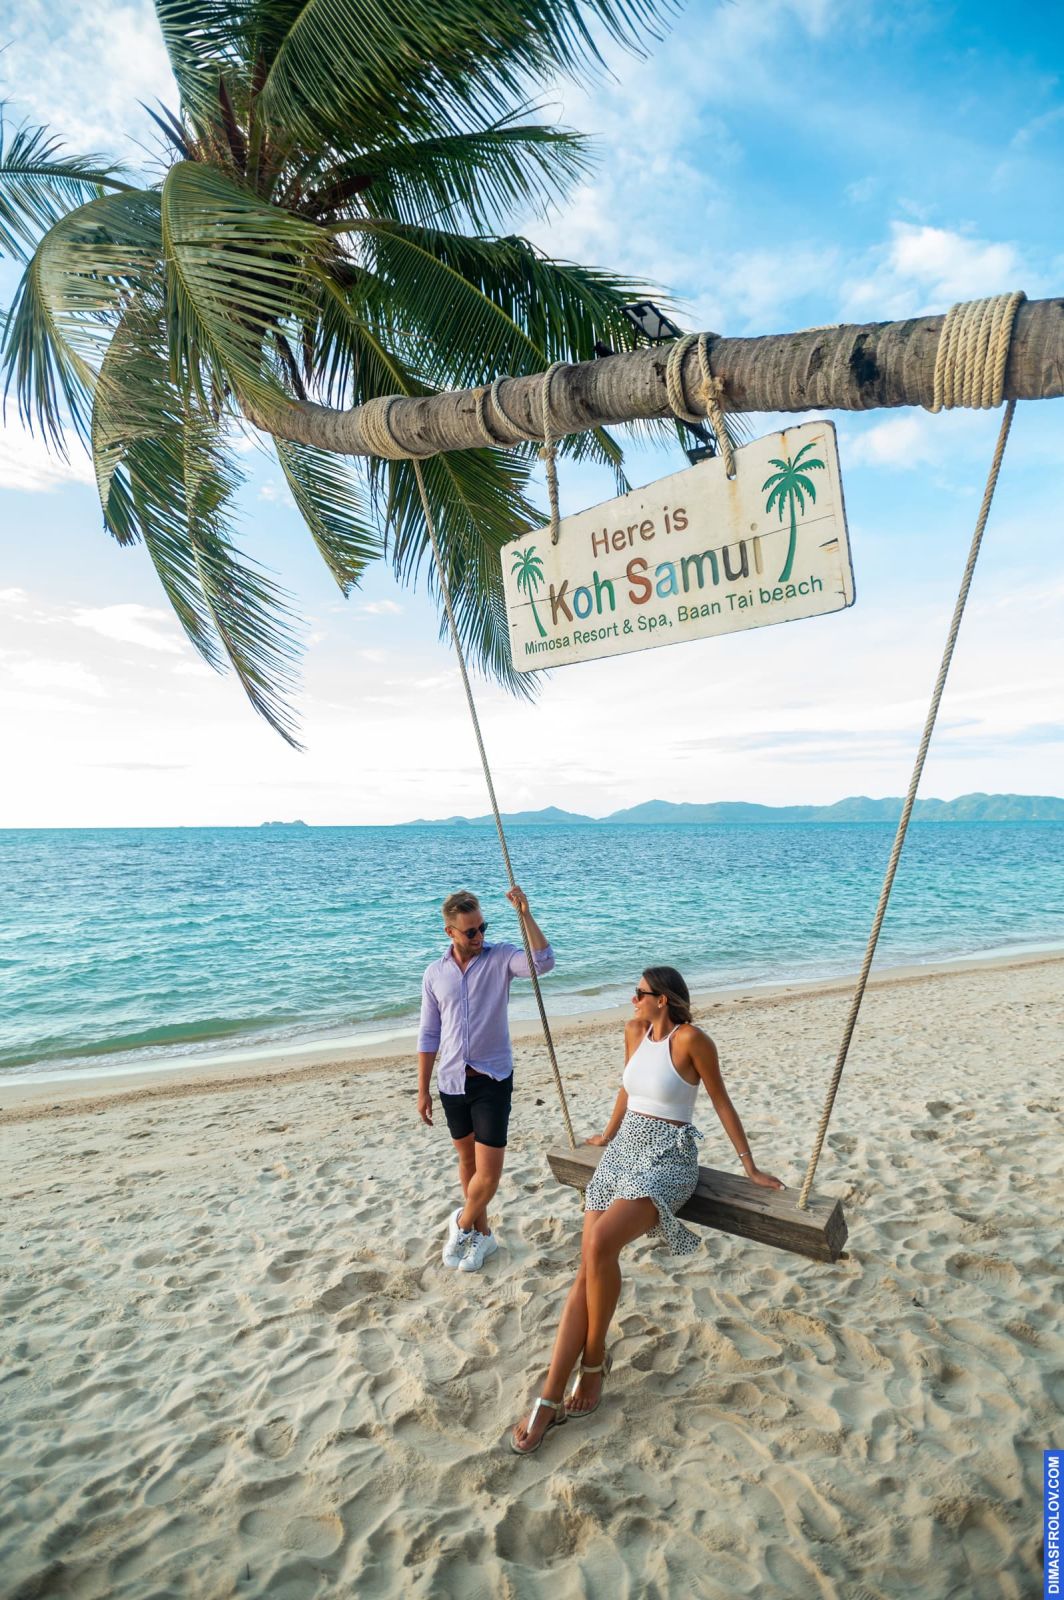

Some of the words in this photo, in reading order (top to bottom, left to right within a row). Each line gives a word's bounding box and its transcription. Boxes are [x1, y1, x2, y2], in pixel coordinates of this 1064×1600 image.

[591, 519, 656, 558] Here
[663, 505, 689, 535] is
[549, 570, 616, 625] Koh
[625, 522, 763, 605] Samui
[524, 635, 571, 655] Mimosa
[573, 624, 619, 645] Resort
[622, 619, 634, 634] &
[637, 613, 673, 633] Spa,
[677, 602, 721, 622] Baan
[725, 590, 754, 611] Tai
[759, 575, 823, 605] beach
